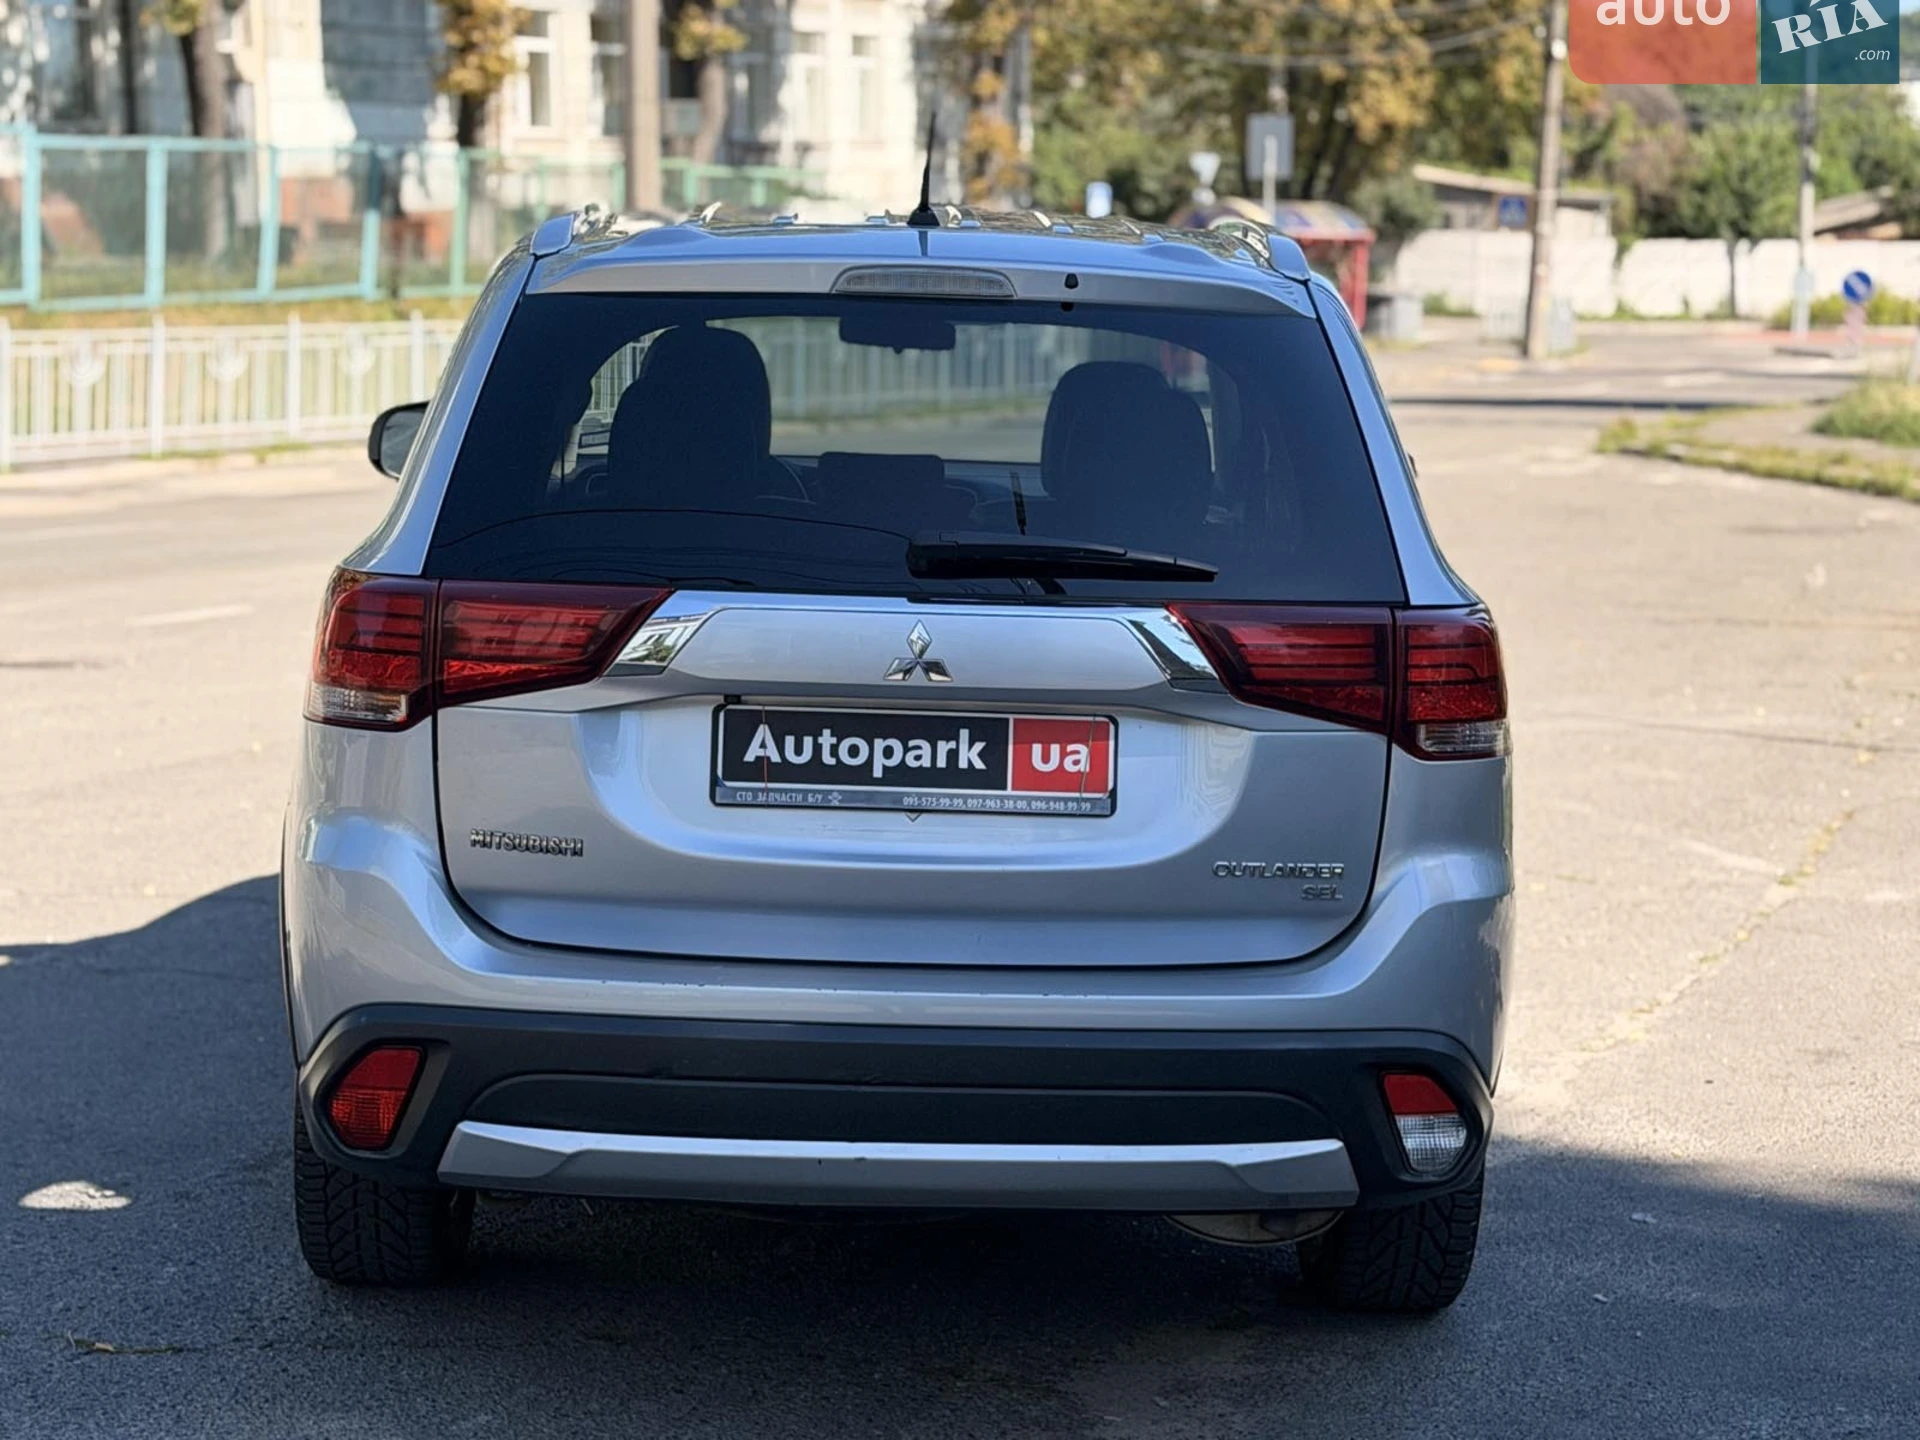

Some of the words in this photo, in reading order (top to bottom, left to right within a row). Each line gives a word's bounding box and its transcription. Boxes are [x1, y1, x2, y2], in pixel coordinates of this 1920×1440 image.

[743, 723, 986, 777] Autopark
[1031, 743, 1091, 773] ua
[736, 791, 754, 802] СТО
[470, 828, 584, 857] MITSUBISHI
[1212, 861, 1345, 879] OUTLANDER
[1301, 884, 1343, 900] SEL
